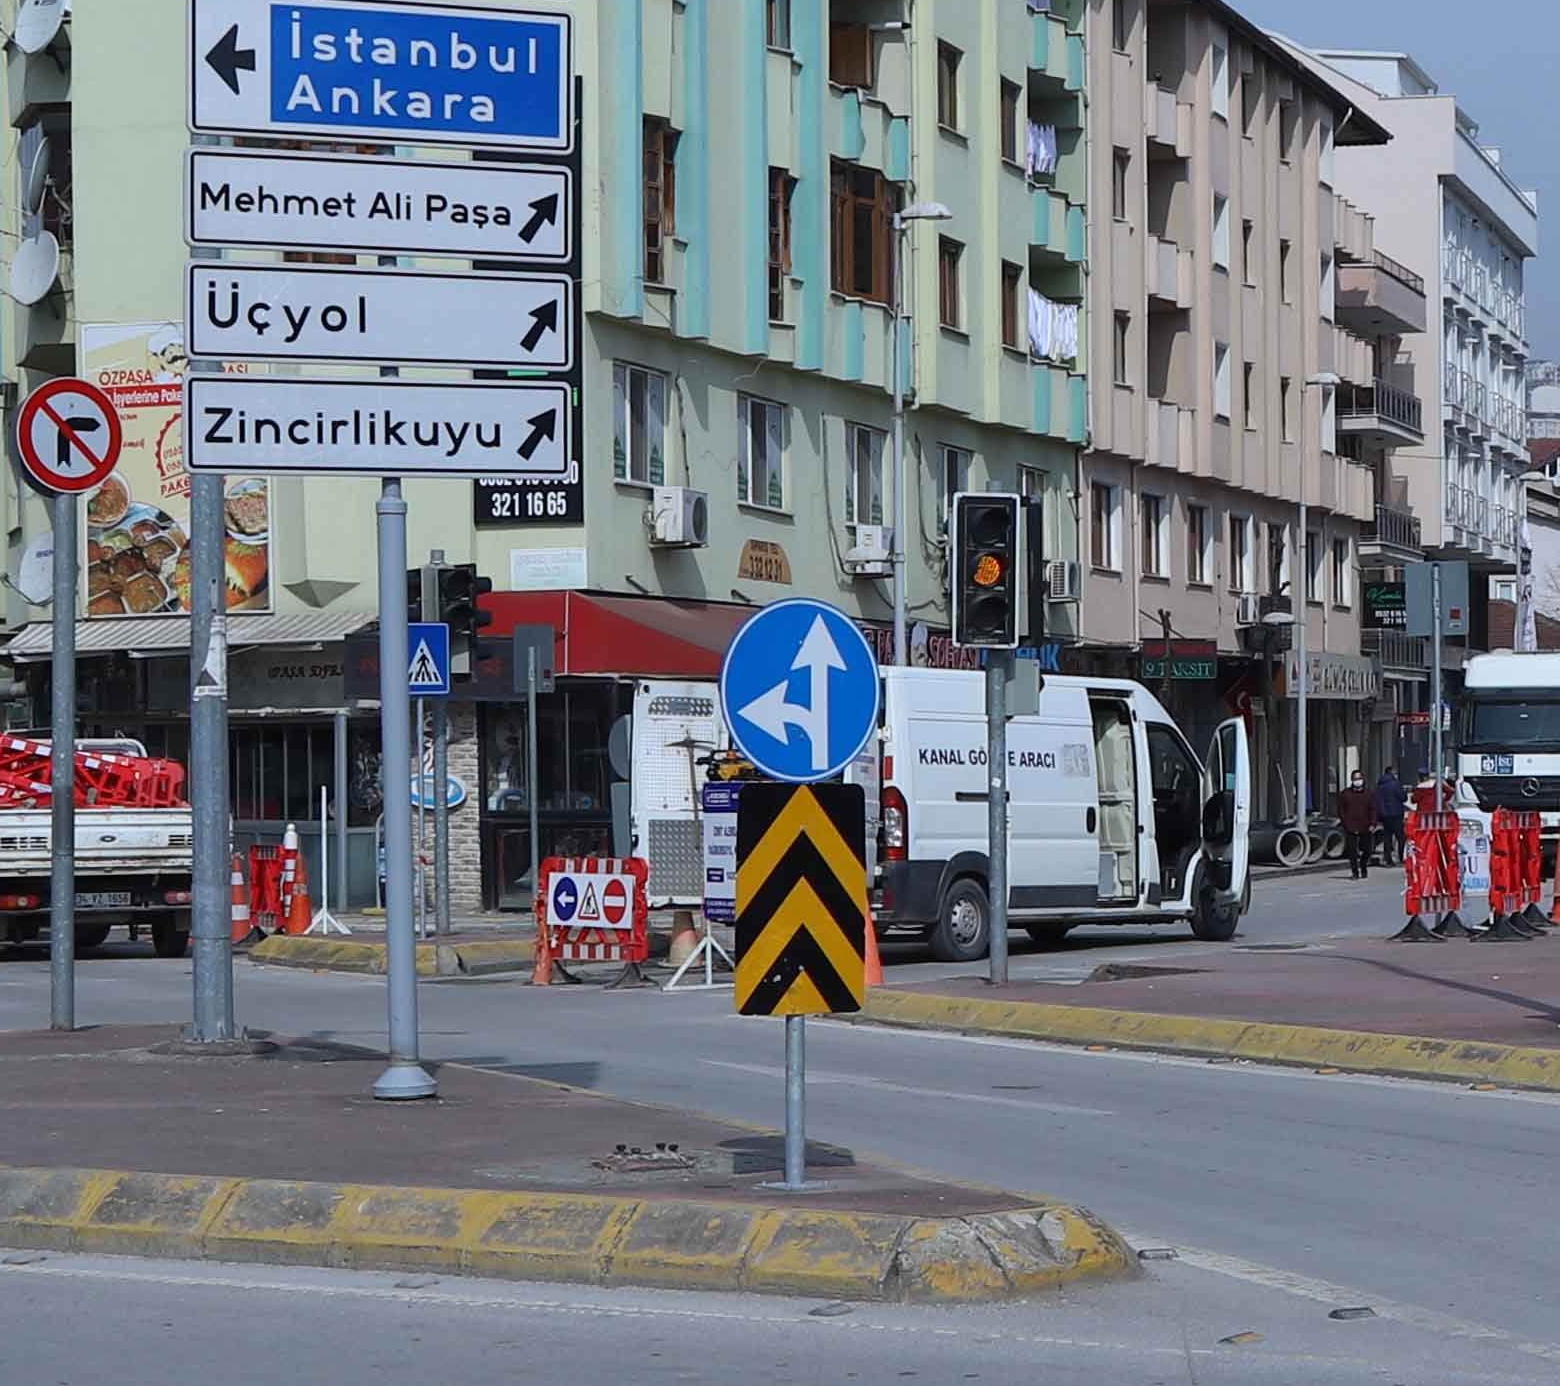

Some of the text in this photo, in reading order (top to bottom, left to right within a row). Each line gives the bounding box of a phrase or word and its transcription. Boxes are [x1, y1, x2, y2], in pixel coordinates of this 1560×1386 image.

[291, 12, 537, 75] İstanbul
[286, 76, 495, 123] Ankara
[200, 182, 511, 230] Mehmet Ali Paşa
[207, 281, 368, 343] Üçyol
[203, 408, 501, 457] Zincirlikuyu
[491, 491, 567, 516] 321 16 65
[918, 748, 965, 766] KANAL
[1019, 752, 1056, 769] ARACI
